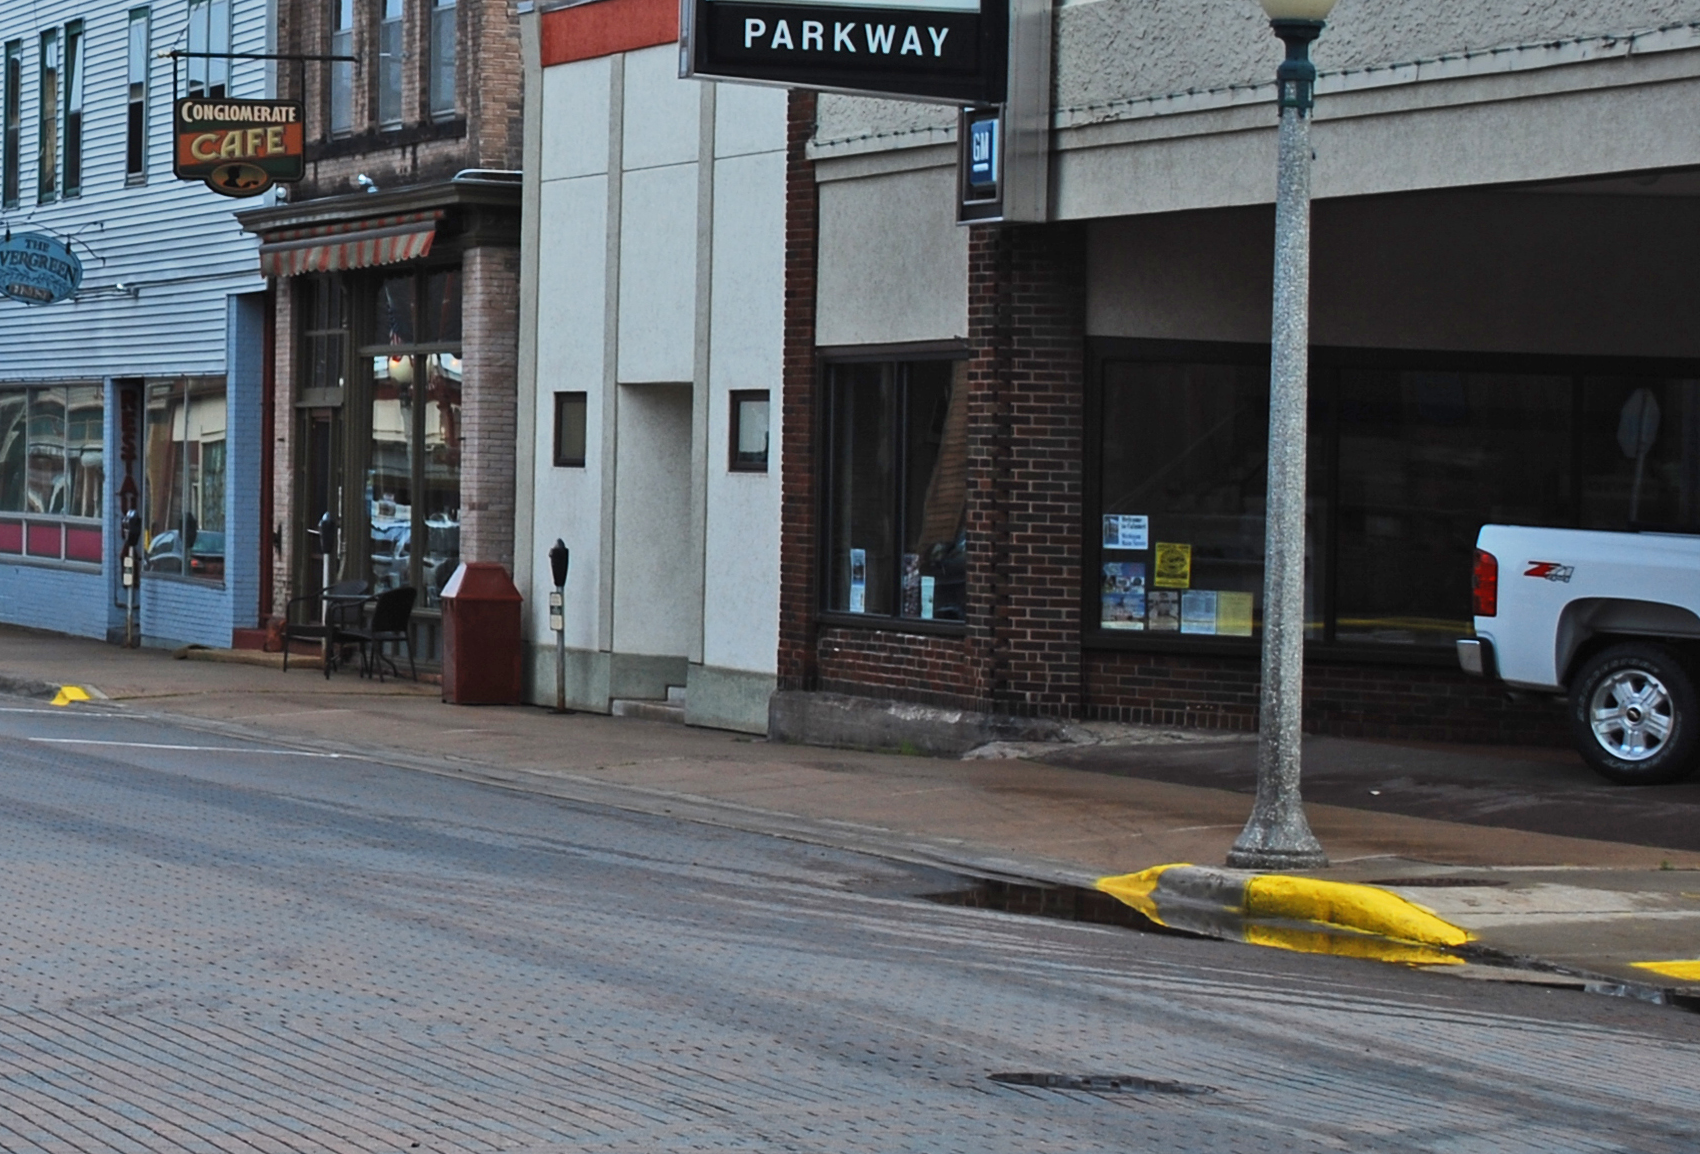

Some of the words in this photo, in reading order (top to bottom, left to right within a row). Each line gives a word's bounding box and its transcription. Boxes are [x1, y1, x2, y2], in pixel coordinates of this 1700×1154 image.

[744, 18, 950, 57] PARKWAY
[181, 101, 297, 123] CONGLOMERATE
[190, 126, 286, 161] CAFE
[972, 131, 990, 162] GM
[25, 238, 50, 253] THE
